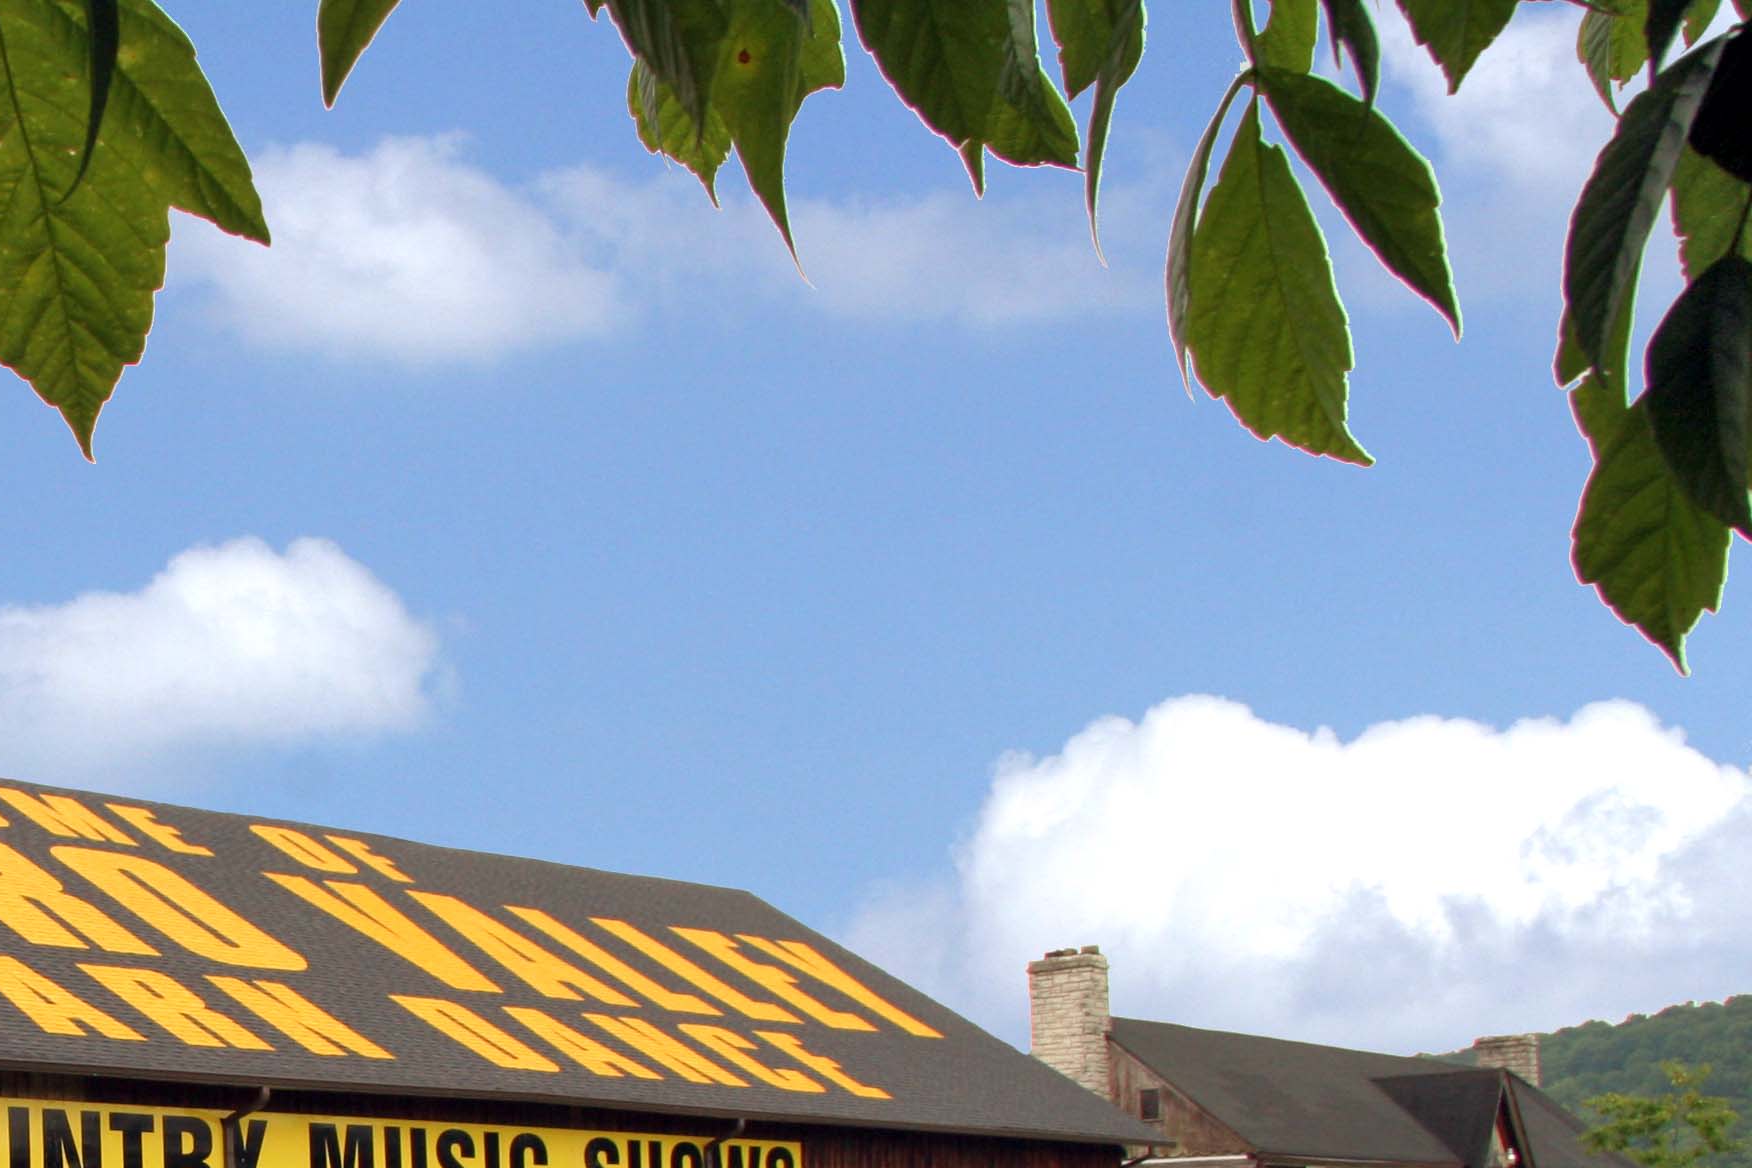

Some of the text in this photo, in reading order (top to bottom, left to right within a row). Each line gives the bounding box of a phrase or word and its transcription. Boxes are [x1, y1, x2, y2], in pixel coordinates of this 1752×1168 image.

[248, 824, 415, 883] OF
[261, 872, 945, 1038] VALLEY
[388, 995, 894, 1100] DANCE
